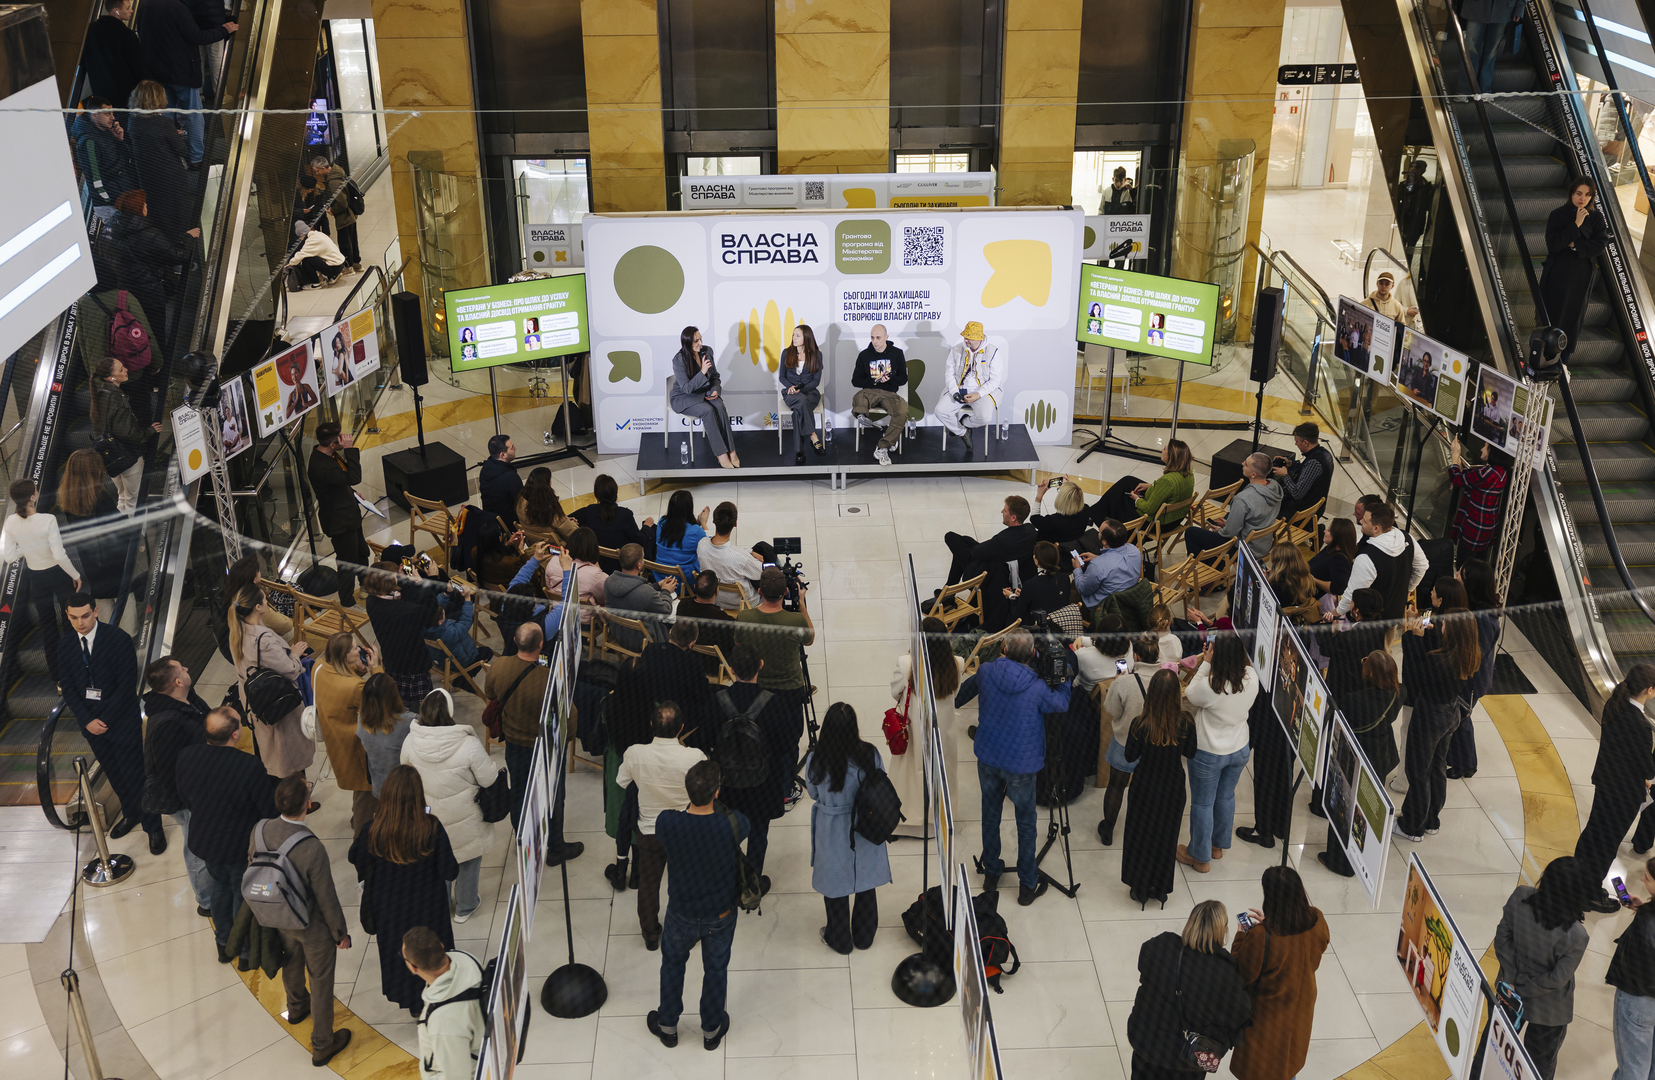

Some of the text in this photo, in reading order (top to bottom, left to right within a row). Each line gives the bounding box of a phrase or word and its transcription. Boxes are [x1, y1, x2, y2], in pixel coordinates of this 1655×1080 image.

[1538, 32, 1549, 51] БІЛЬШЕ
[1546, 57, 1556, 71] БУЛО
[1572, 136, 1582, 149] ЩОБ
[721, 233, 818, 248] ВЛАСНА
[722, 250, 819, 264] СПРАВА
[844, 290, 930, 300] СЬОГОДНІ ТИ ЗАХИЩАЄШ
[1090, 282, 1118, 291] «ВЕТЕРАНИ
[1144, 289, 1155, 298] ПРО
[1155, 291, 1171, 300] ШЛЯХ
[1171, 294, 1180, 302] ДО
[1180, 295, 1200, 305] УСПІХУ
[1608, 242, 1641, 329] ЩОБ ЯСНА БІЛЬШЕ НЕ КРОВИЛИ
[456, 303, 486, 314] «ВЕТЕРАНИ
[487, 302, 491, 311] У
[513, 298, 524, 307] ПРО
[525, 295, 541, 305] ШЛЯХ
[541, 294, 549, 303] ДО
[550, 292, 569, 302] УСПІХУ
[464, 310, 490, 321] ВЛАСНИЙ
[491, 308, 511, 318] ДОСВІД
[512, 304, 542, 315] ОТРИМАННЯ
[542, 301, 566, 311] ГРАНТУ»
[844, 302, 895, 311] БАТЬКІВЩИНУ,
[897, 302, 923, 310] ЗАВТРА
[1097, 289, 1120, 300] ВЛАСНИЙ
[1121, 294, 1140, 304] ДОСВІД
[1141, 296, 1172, 308] ОТРИМАННЯ
[1172, 303, 1195, 313] ГРАНТУ»
[844, 312, 941, 321] СТВОРЮЄШ ВЛАСНУ СПРАВУ
[65, 321, 74, 340] ЗУБАХ
[60, 346, 68, 364] ДІРОК
[1640, 342, 1650, 358] ЩОБ
[56, 364, 65, 379] ЩОБ
[33, 395, 57, 479] ЯСНА БІЛЬШЕ НЕ КРОВИЛИ
[1556, 492, 1577, 541] ЗАБЛОЦЬКОГО
[1572, 542, 1584, 567] КЛІНІКА
[6, 569, 17, 594] КЛІНІКА
[1455, 950, 1474, 989] ВЛАСНА
